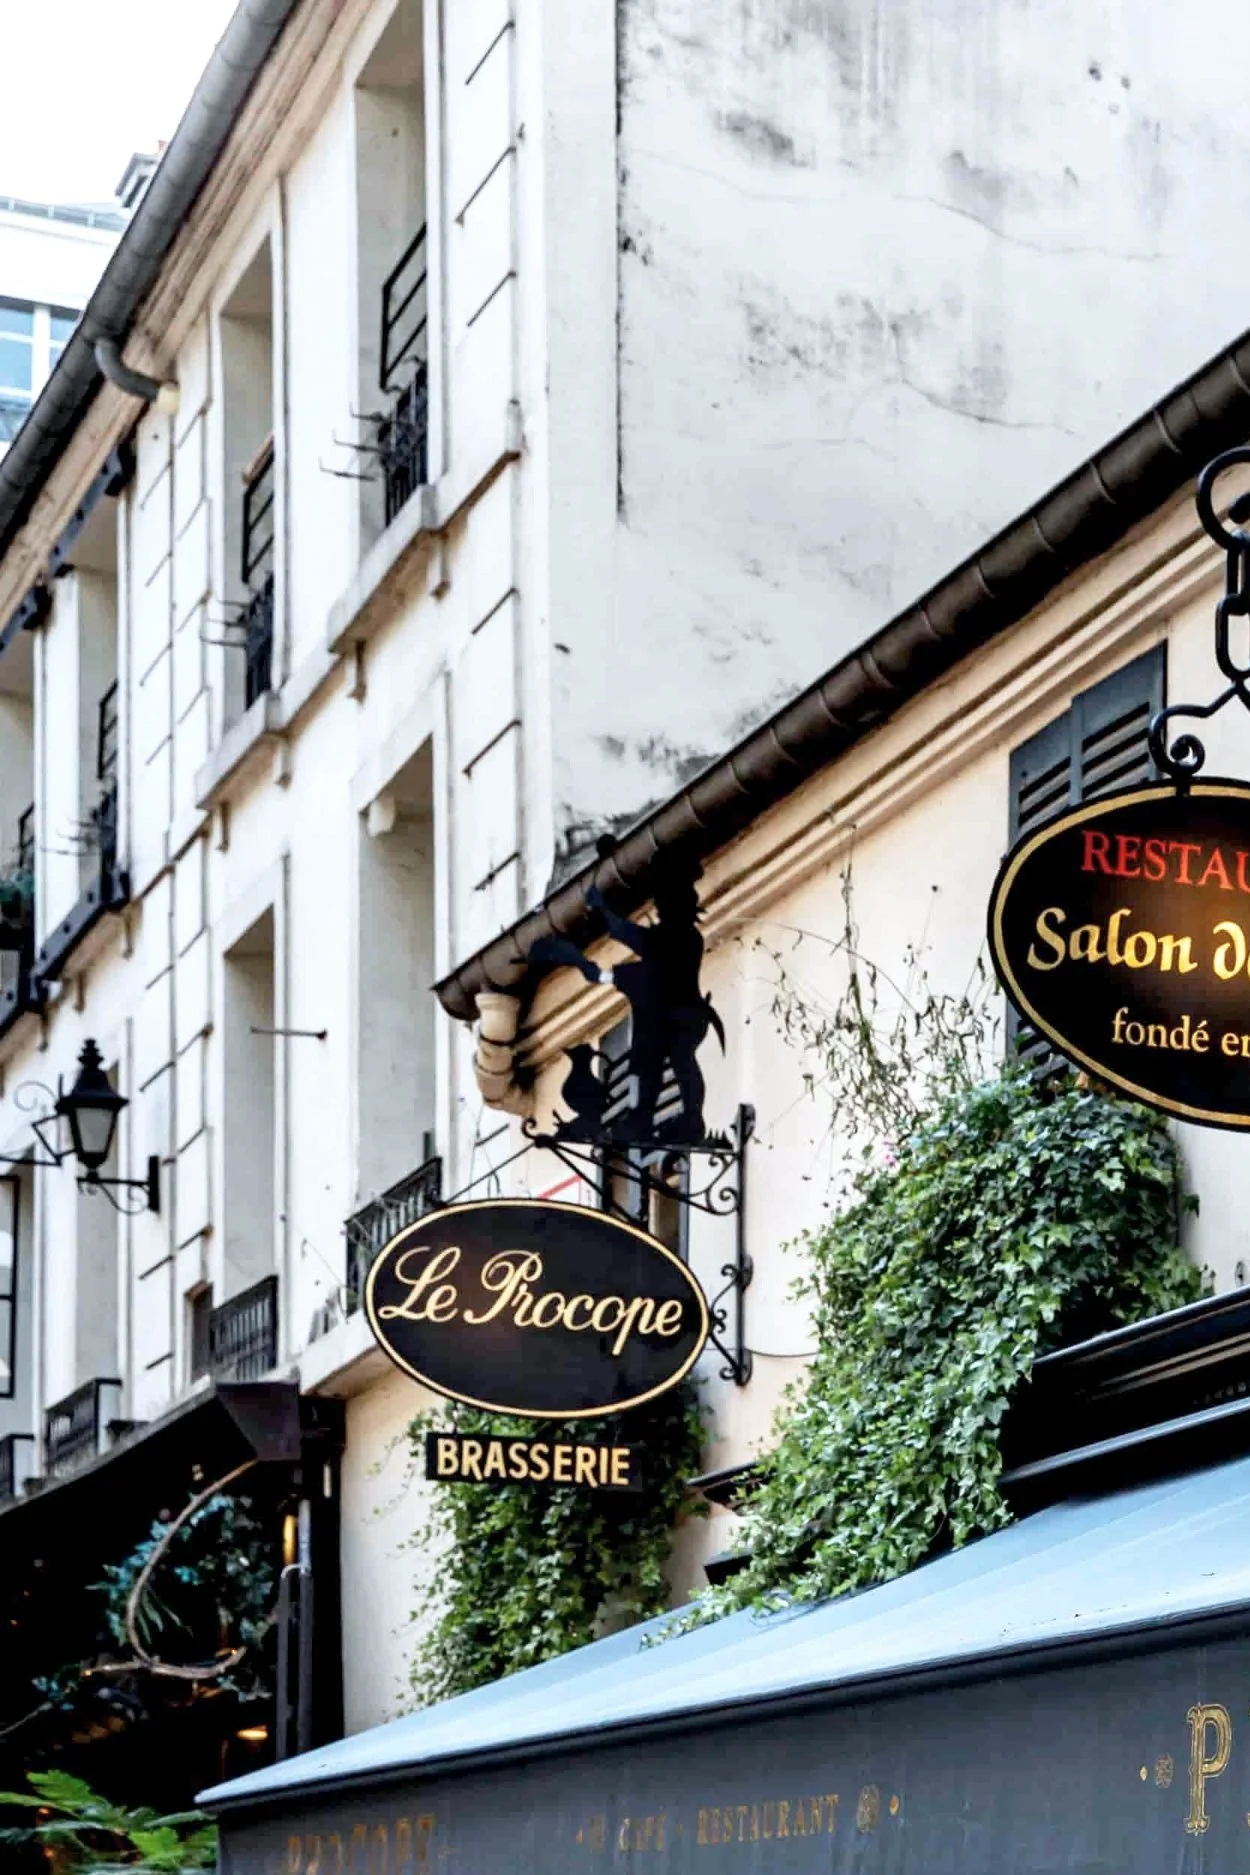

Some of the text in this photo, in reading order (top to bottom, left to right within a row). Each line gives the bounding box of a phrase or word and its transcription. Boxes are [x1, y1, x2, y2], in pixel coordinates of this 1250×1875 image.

[1027, 907, 1198, 973] Salon
[1111, 1007, 1210, 1053] fondé
[379, 1246, 684, 1356] Le Procope
[437, 1438, 630, 1487] BRASSERIE
[697, 1794, 839, 1845] RESTAURANT
